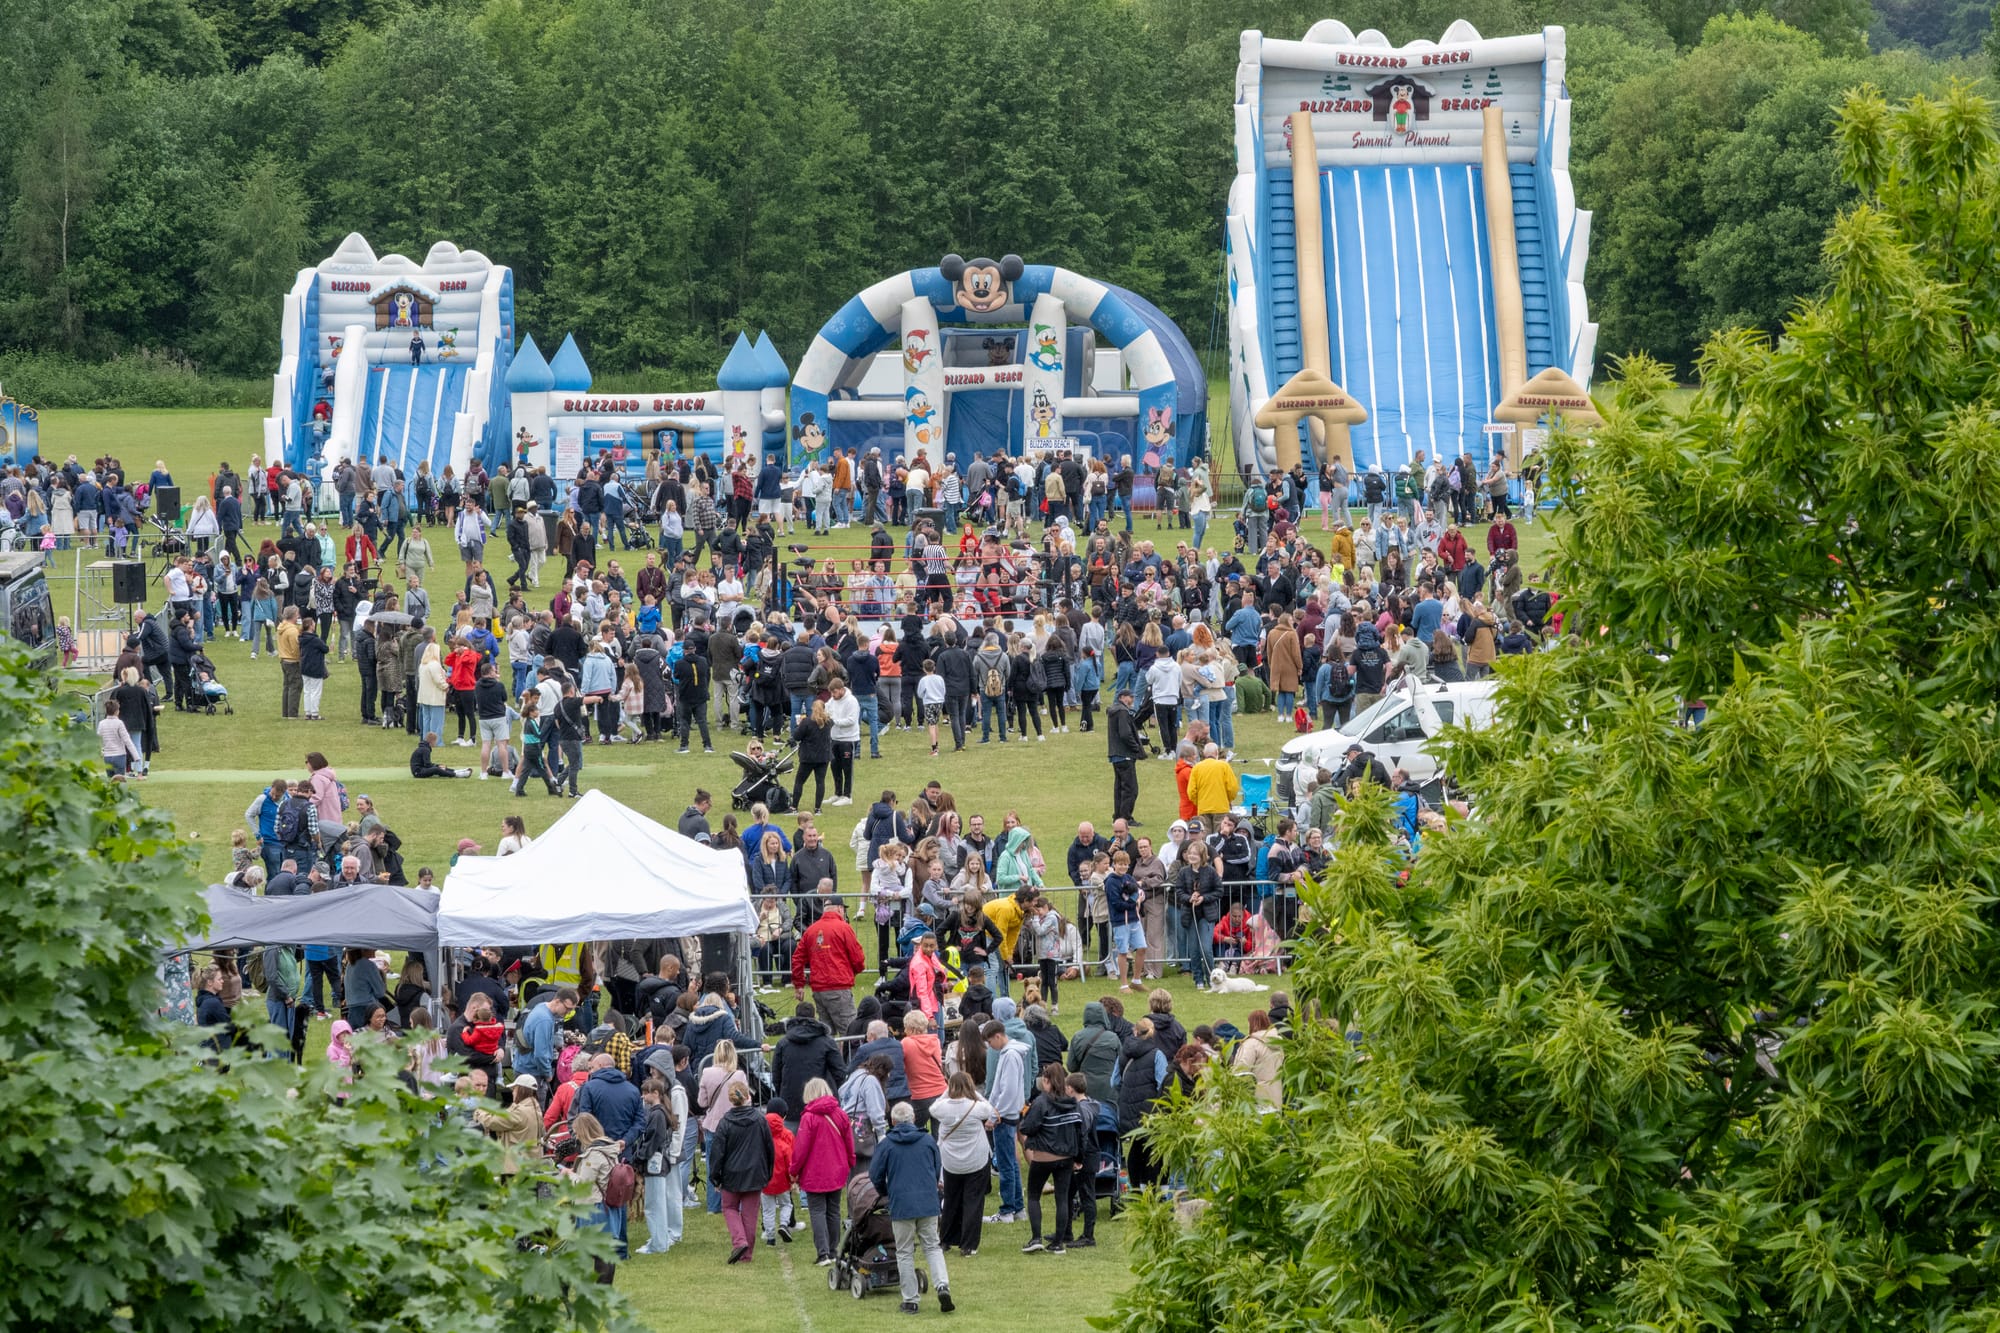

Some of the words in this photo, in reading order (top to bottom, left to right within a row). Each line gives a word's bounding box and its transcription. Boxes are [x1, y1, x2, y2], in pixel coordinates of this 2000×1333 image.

[1338, 54, 1408, 69] BLIZZARD
[1421, 51, 1470, 66] BEACH
[1299, 100, 1373, 114] BLIZZARD
[1441, 98, 1491, 112] BEACH
[1352, 131, 1393, 149] Summit
[331, 281, 371, 292] BLIZZARD
[439, 280, 467, 291] BEACH
[944, 373, 985, 386] BLIZZARD
[994, 371, 1023, 383] BEACH
[563, 399, 640, 413] BLIZZARD
[652, 398, 706, 412] BEACH
[1276, 400, 1316, 408] BLIZZARD
[1317, 398, 1345, 407] BEACH
[1559, 399, 1587, 407] BEACH
[1029, 440, 1053, 449] BLIZZARD
[1054, 440, 1070, 449] BEACH
